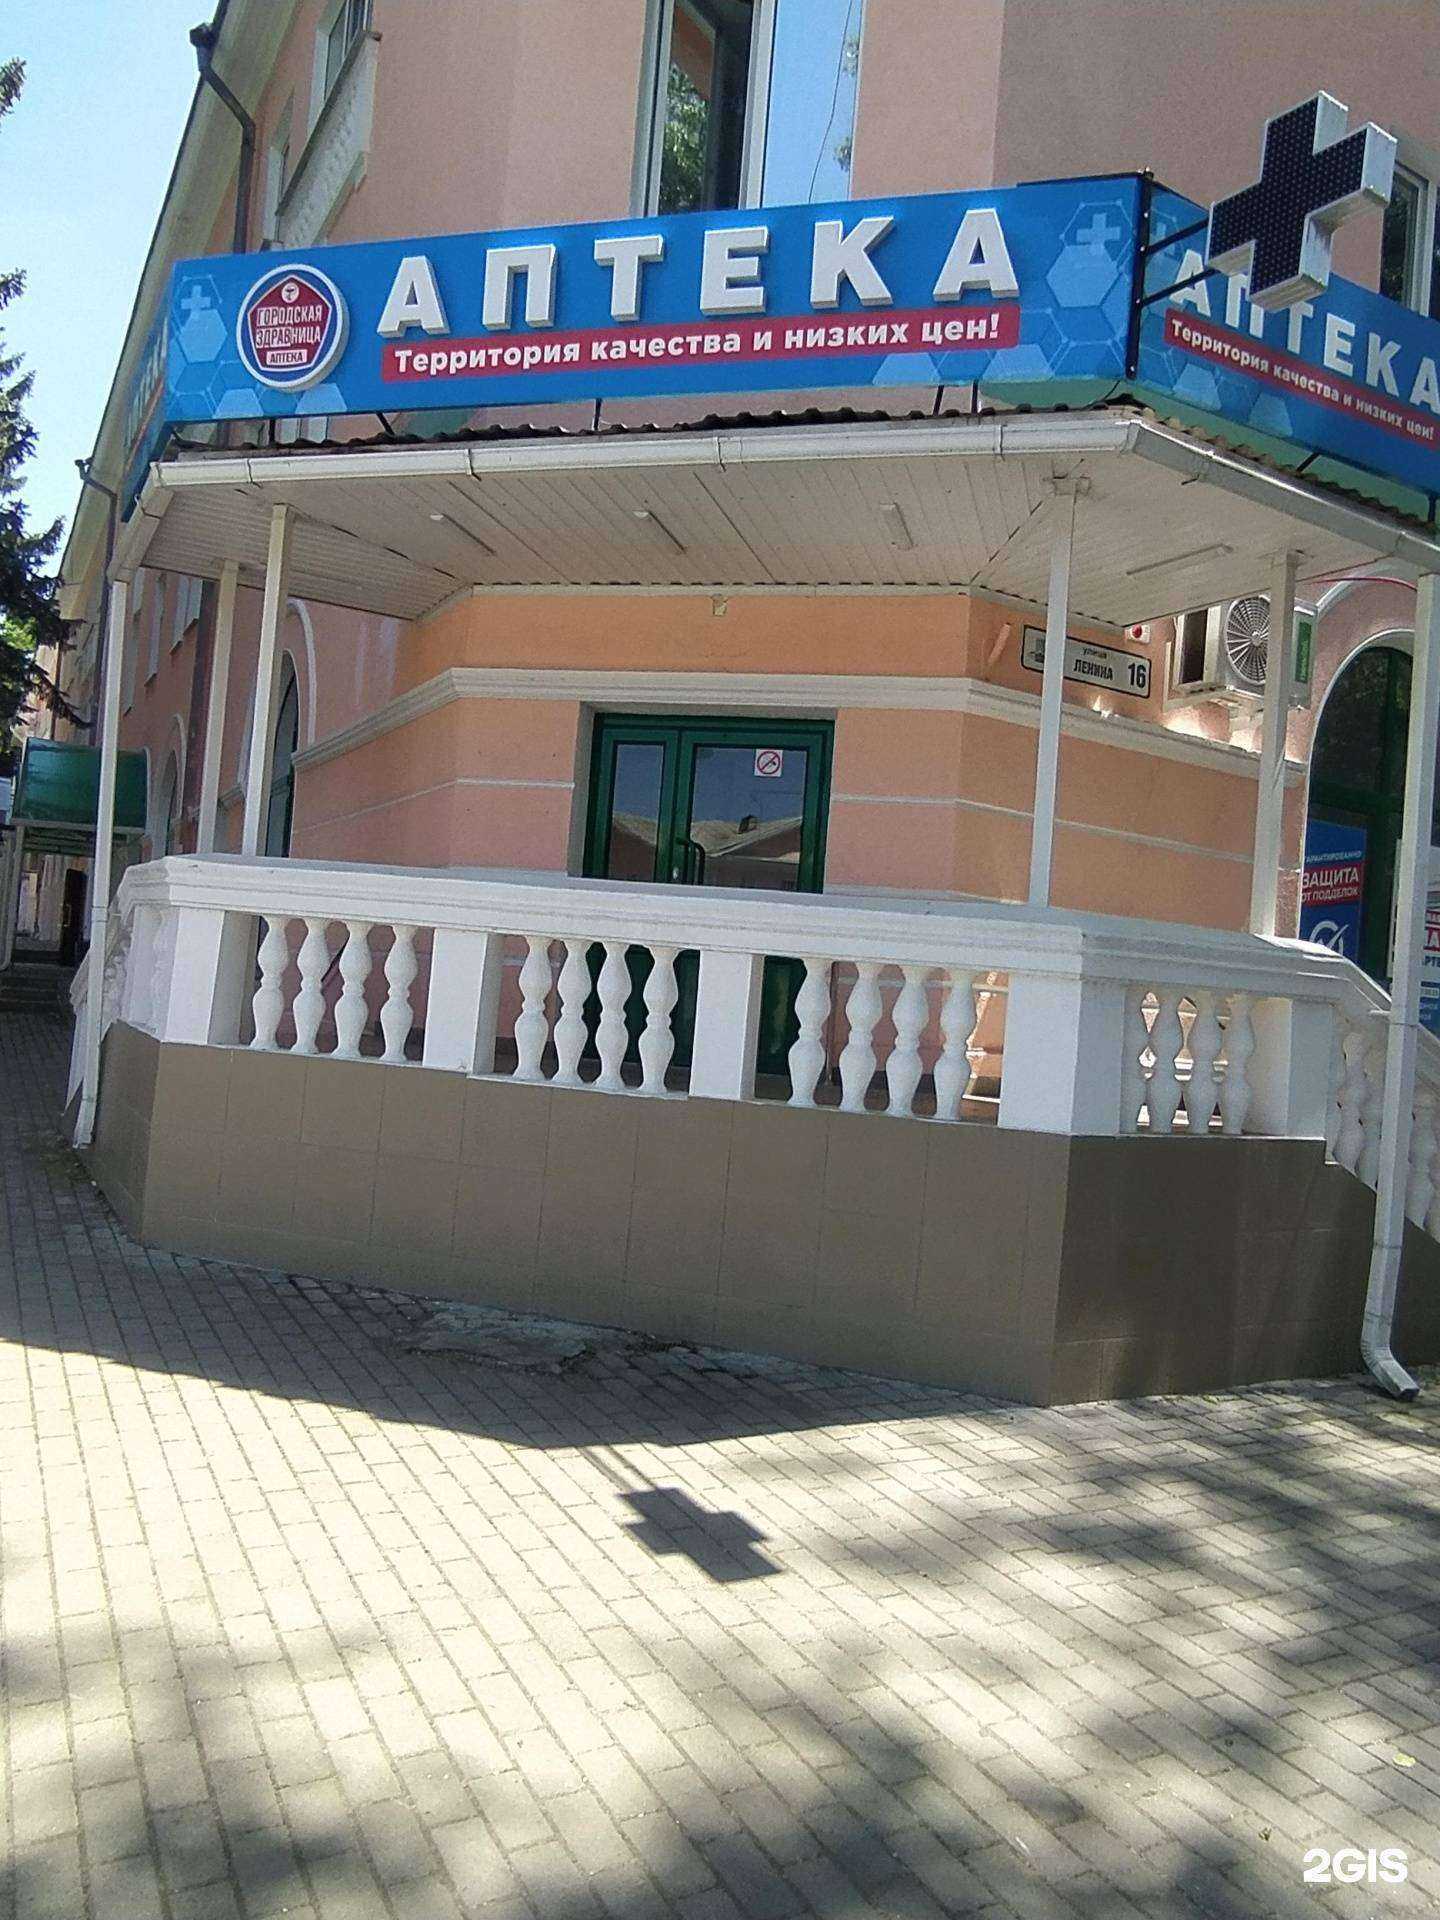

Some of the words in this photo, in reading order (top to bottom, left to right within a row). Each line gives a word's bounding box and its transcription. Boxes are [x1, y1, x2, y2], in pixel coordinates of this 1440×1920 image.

[377, 208, 1020, 338] АПТЕКА
[257, 305, 323, 327] ГОРОДСКАЯ
[256, 326, 321, 348] ЗДРАВНИЦА
[395, 342, 580, 376] Территория
[591, 333, 741, 360] качества
[753, 331, 772, 352] и
[784, 323, 908, 348] низких
[921, 313, 999, 345] цен!
[270, 352, 303, 364] АПТЕКА
[1172, 318, 1269, 373] Территория
[1273, 364, 1340, 402] качества
[1343, 393, 1352, 407] и
[1356, 397, 1403, 427] низких
[1407, 419, 1434, 441] цен!
[1073, 659, 1114, 681] ЛЕНИНА
[1127, 662, 1147, 689] 16
[1302, 866, 1359, 889] ЗАЩИТА
[1312, 887, 1359, 901] ПОДДЕЛОК
